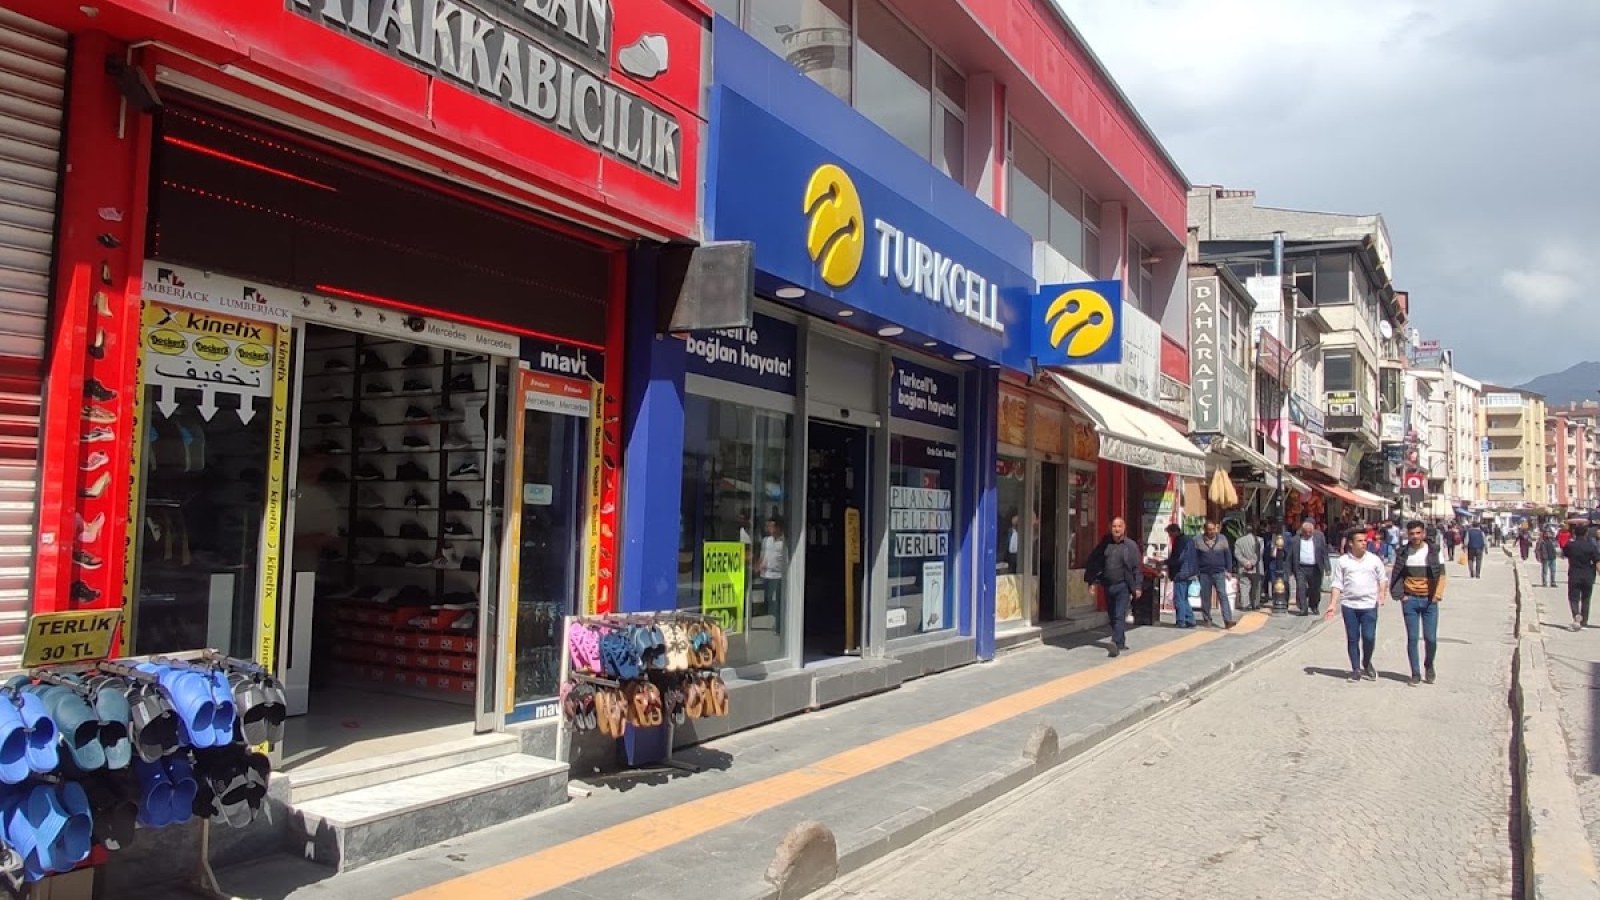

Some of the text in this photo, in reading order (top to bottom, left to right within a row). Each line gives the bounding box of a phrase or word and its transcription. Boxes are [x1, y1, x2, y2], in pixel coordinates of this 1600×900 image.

[875, 218, 1005, 333] TURKCELL
[219, 297, 290, 319] LUMBERJACK
[187, 313, 262, 341] kinetix
[427, 322, 513, 350] Mercedes Mercedes
[540, 350, 588, 376] mavi
[686, 335, 792, 378] bağlan hayata!
[1194, 286, 1214, 423] BAHARATÇI
[155, 360, 261, 389] تخفيف
[898, 387, 928, 411] bağlan
[892, 510, 951, 530] TELEFON
[38, 615, 112, 636] TERLİK
[40, 642, 94, 660] 30 TL
